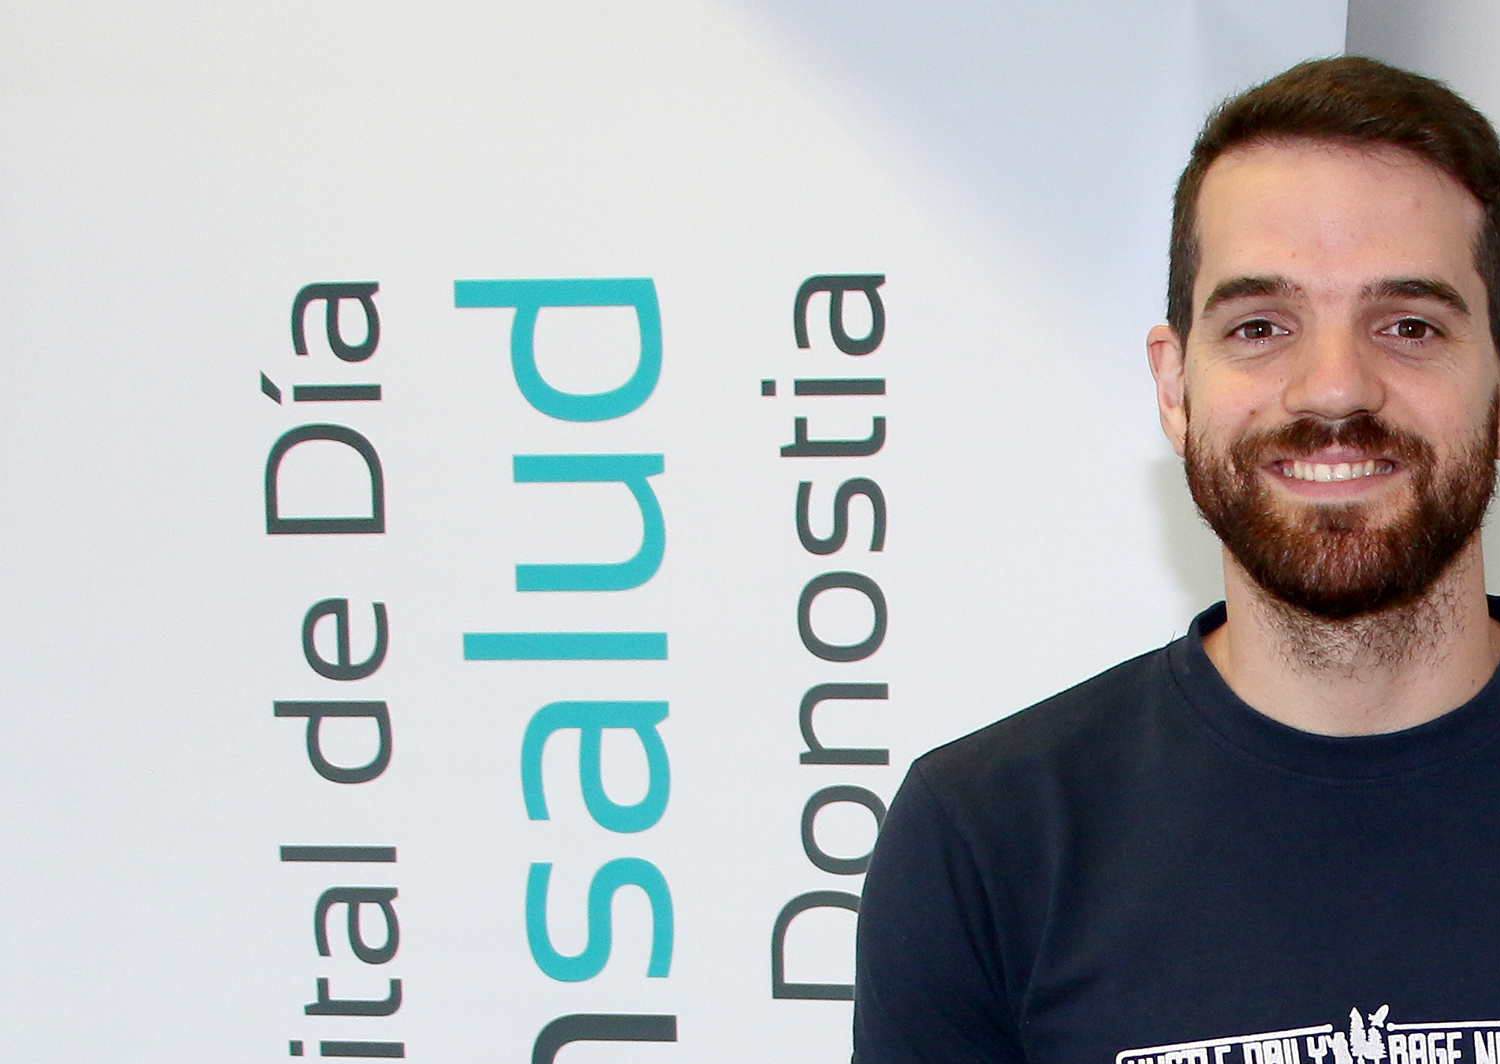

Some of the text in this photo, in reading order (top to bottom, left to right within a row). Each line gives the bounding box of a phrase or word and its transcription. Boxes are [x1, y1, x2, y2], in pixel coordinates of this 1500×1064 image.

[260, 281, 386, 535] Día
[272, 597, 393, 784] de
[761, 273, 890, 1001] Donostia
